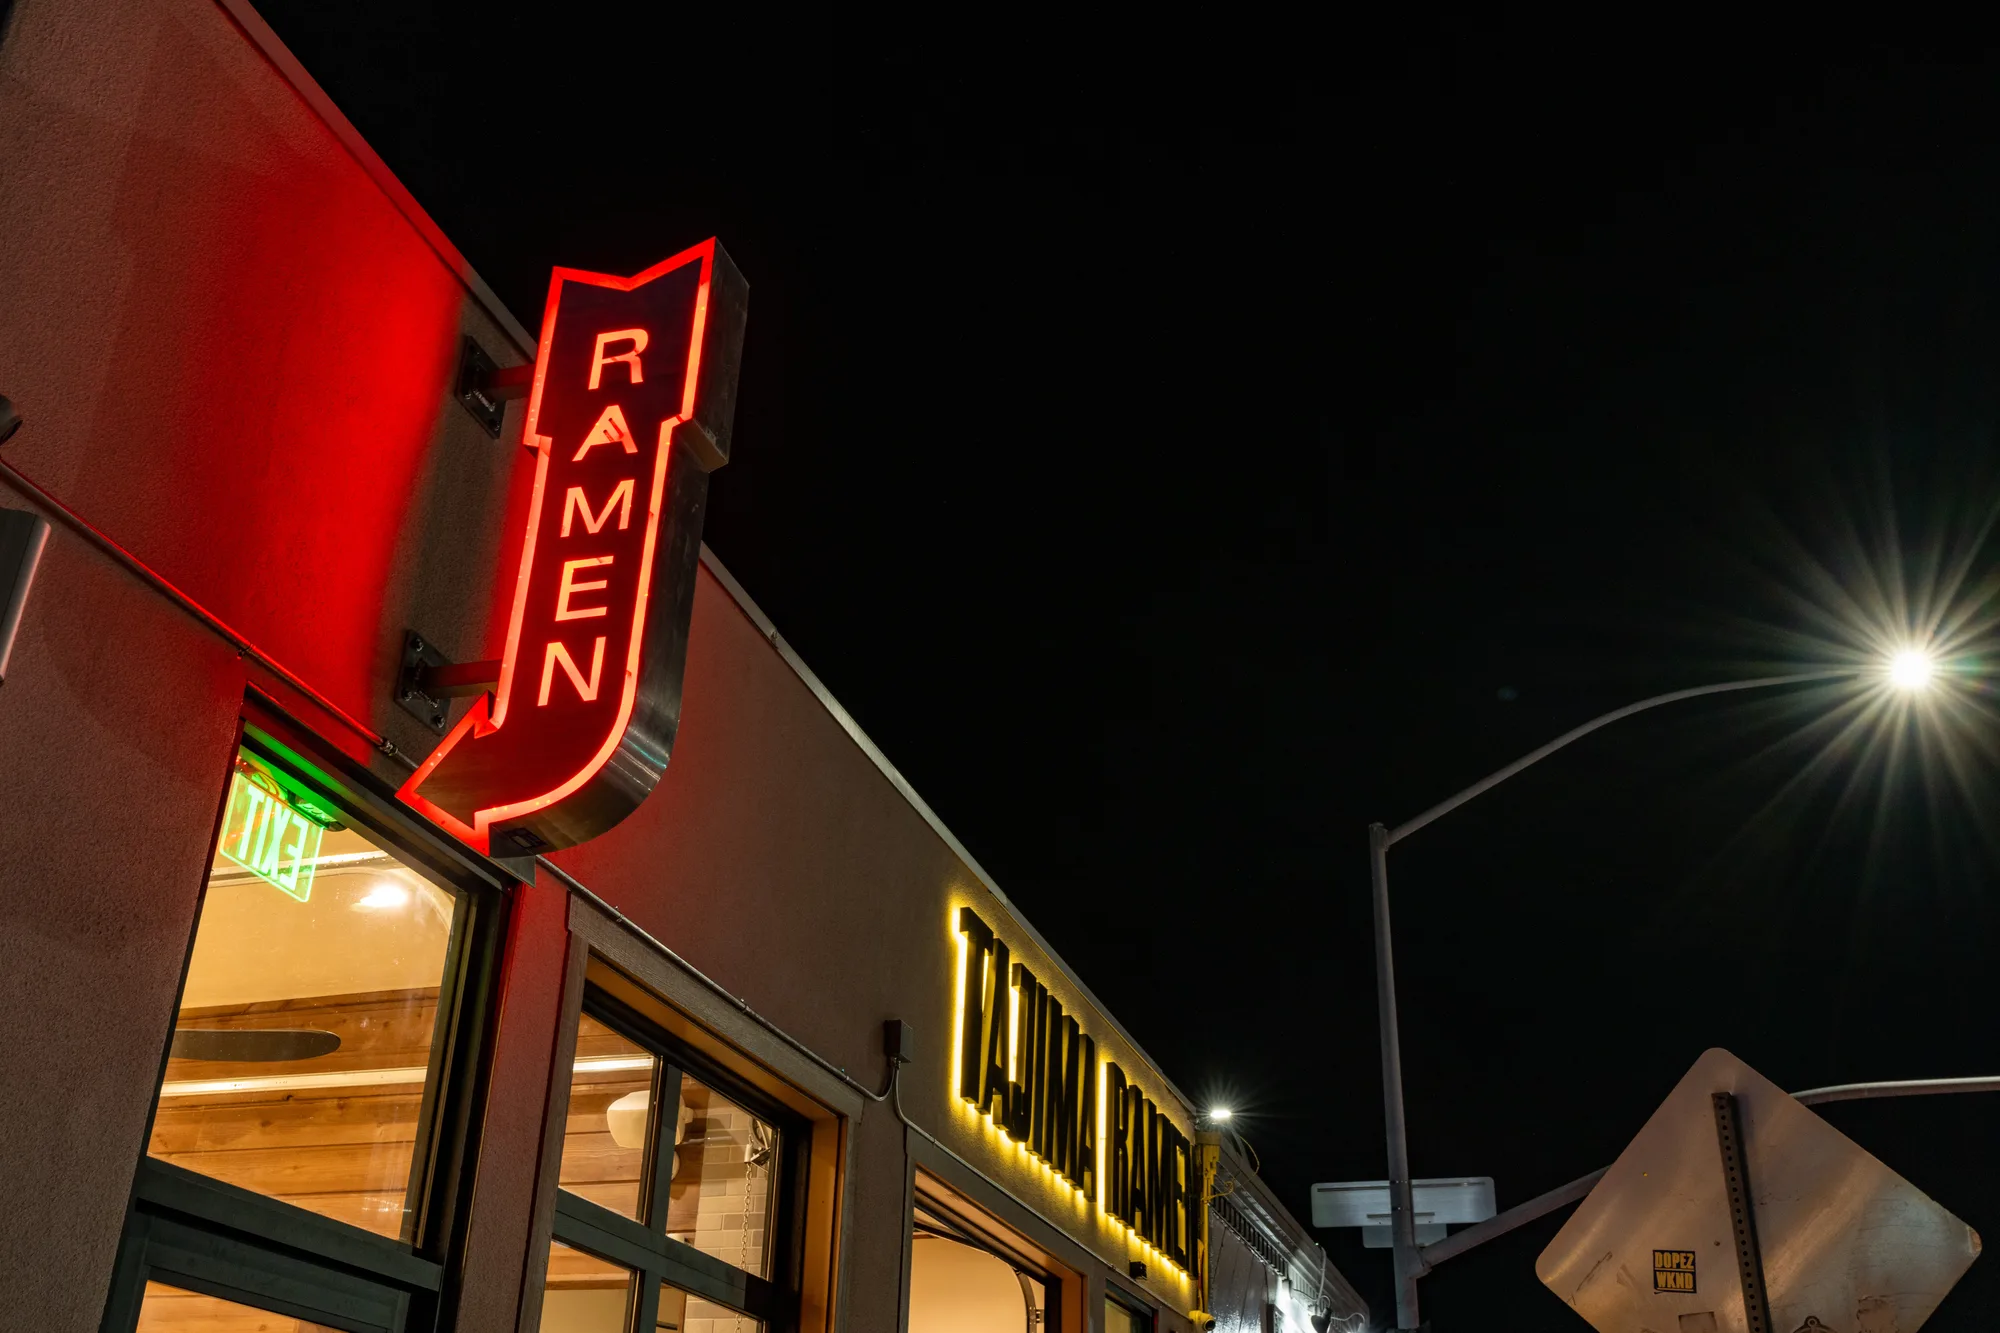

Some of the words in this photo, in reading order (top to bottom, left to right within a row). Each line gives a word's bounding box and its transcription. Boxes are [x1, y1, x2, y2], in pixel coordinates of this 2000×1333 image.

[537, 328, 649, 707] RAMEN
[960, 906, 1096, 1202] TAJIMA
[1654, 1251, 1695, 1269] DOPEZ
[1655, 1271, 1694, 1289] WKND
